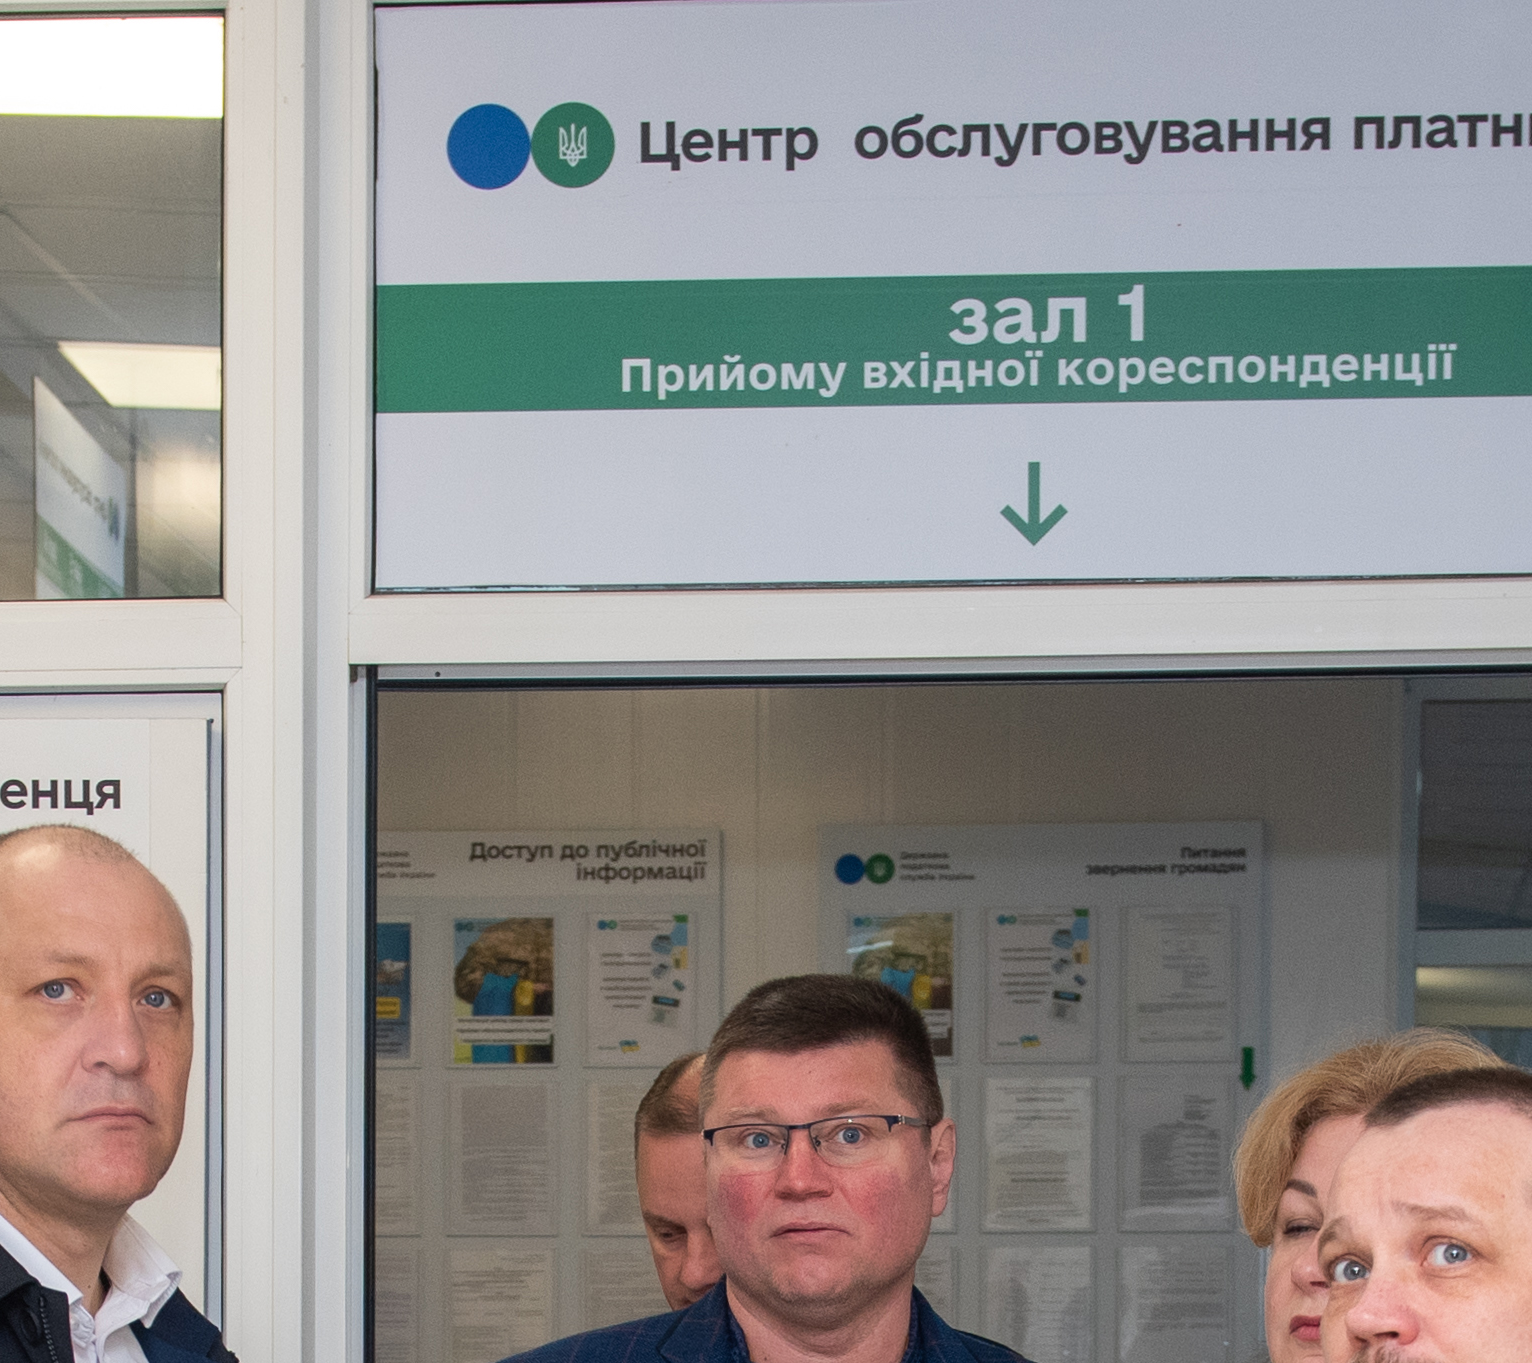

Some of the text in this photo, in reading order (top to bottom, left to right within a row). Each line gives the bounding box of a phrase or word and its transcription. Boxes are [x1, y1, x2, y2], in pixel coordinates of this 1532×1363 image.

[639, 121, 819, 171] Центр
[853, 115, 1331, 166] обслуговування
[947, 284, 1145, 344] зал 1
[621, 343, 1458, 400] Прийому вхідної кореспонденції
[468, 839, 707, 866] Доступ до публічної
[1179, 846, 1247, 859] Питання
[575, 858, 708, 885] інформації
[1085, 862, 1247, 876] звернення громадян
